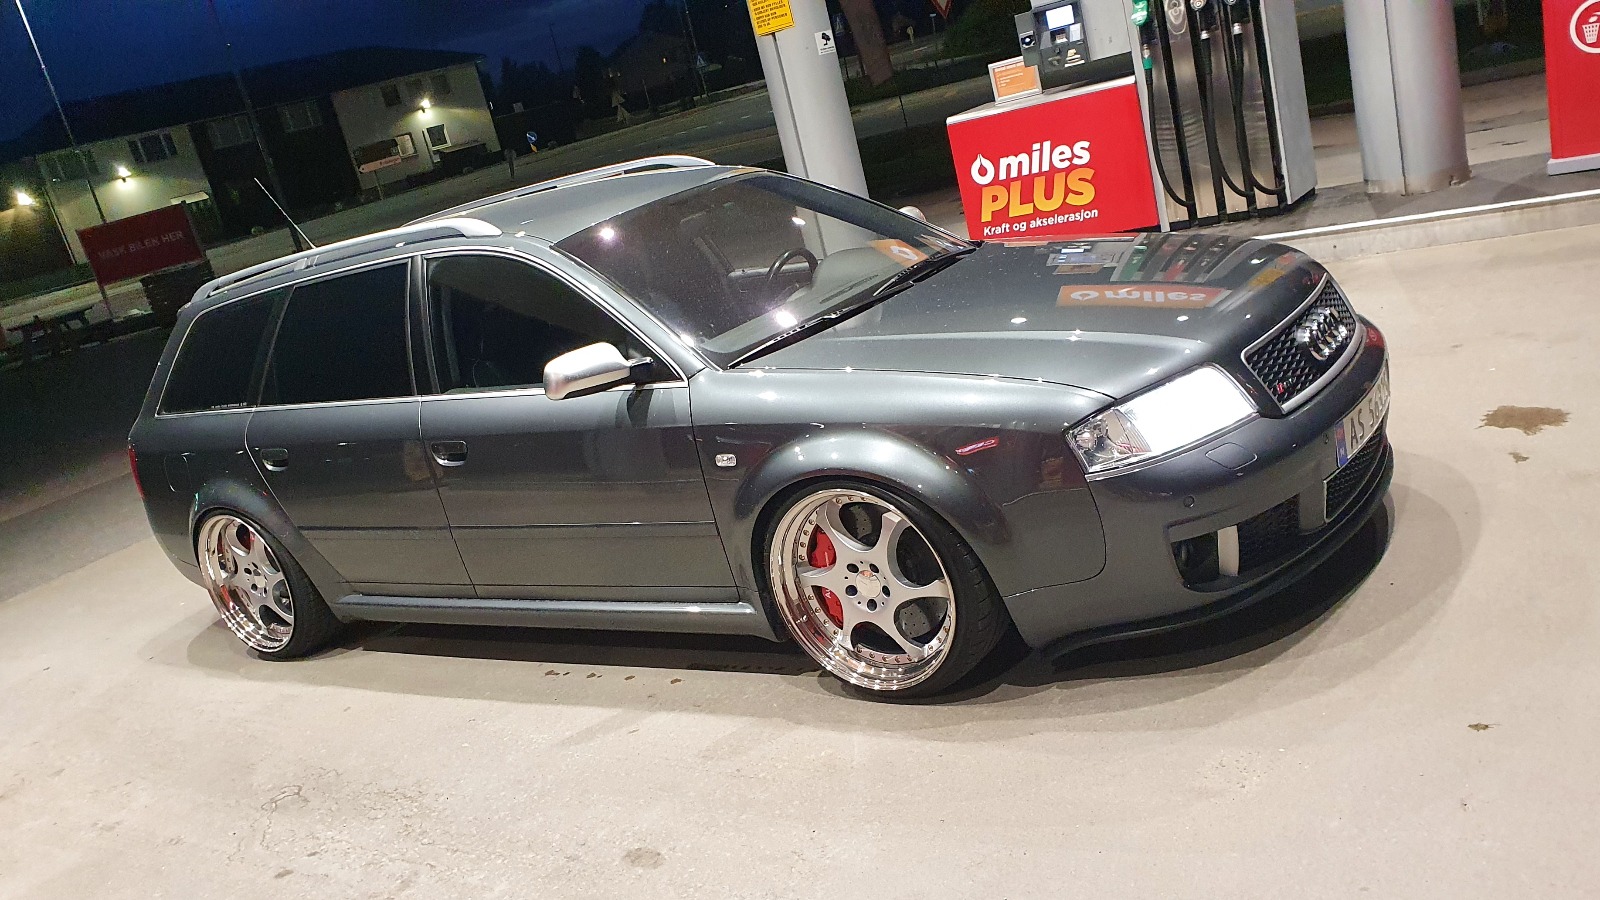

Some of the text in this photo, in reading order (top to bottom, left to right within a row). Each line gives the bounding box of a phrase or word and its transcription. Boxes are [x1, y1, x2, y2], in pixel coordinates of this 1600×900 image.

[998, 140, 1091, 181] miles
[981, 167, 1096, 222] PLUS
[128, 236, 160, 253] BILEN
[161, 230, 185, 243] HER
[983, 209, 1099, 236] Kraft og akselerasjon
[1350, 408, 1365, 450] AS
